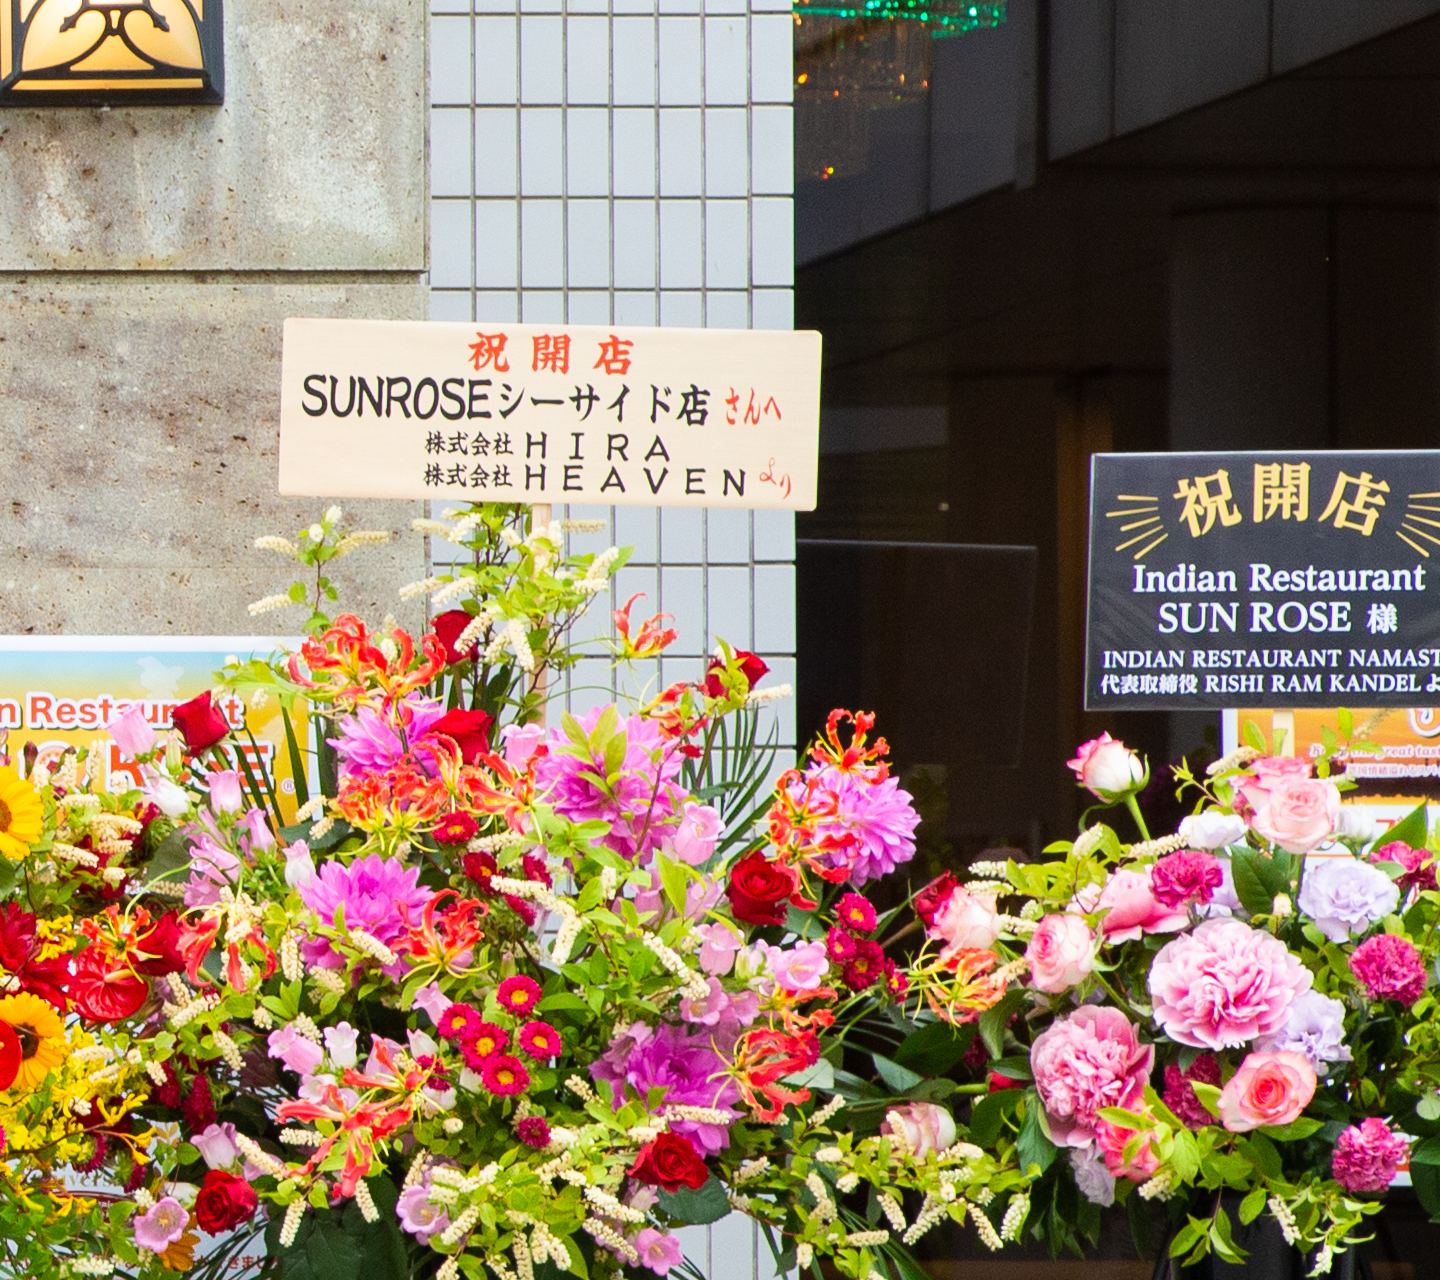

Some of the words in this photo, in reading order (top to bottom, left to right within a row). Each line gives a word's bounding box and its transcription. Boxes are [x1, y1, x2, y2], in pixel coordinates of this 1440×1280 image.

[468, 331, 635, 376] 祝開店
[301, 374, 711, 427] SUNROSEシーサイド店
[724, 387, 783, 426] さんへ
[1172, 461, 1392, 538] 祝開店
[1132, 563, 1238, 593] Indian
[1248, 563, 1426, 592] Restaurant
[1158, 602, 1240, 634] SUN
[1249, 601, 1353, 633] ROSE
[1366, 603, 1398, 635] 様
[1103, 650, 1185, 669] INDIAN
[1191, 649, 1342, 668] RESTAURANT
[1100, 673, 1198, 695] 代表取締役
[1205, 674, 1264, 693] RISHI
[1271, 674, 1322, 693] RAM
[1329, 673, 1422, 693] KANDEL
